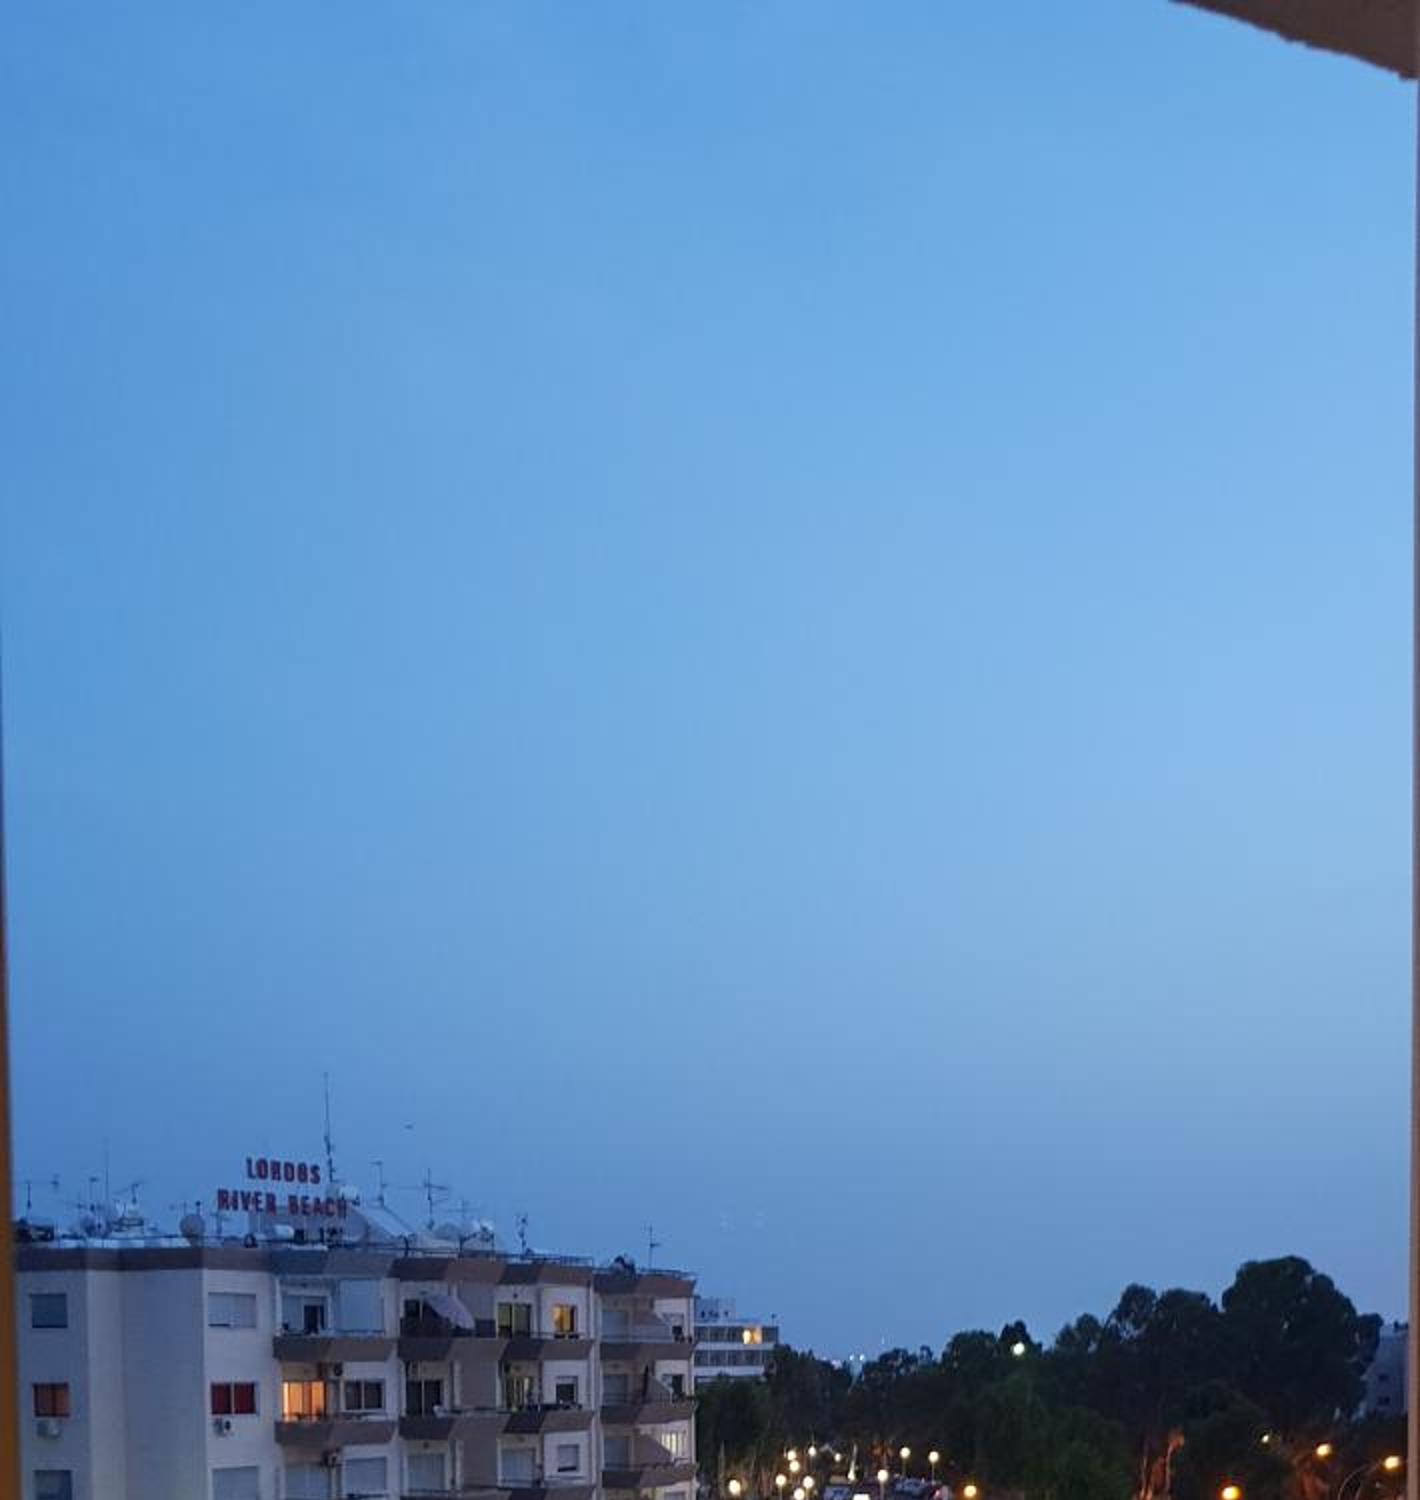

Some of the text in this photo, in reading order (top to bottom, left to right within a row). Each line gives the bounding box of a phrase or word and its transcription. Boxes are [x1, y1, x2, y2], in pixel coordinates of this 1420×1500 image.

[246, 1156, 320, 1184] LORDOS
[216, 1188, 347, 1218] RIVER BEACH
